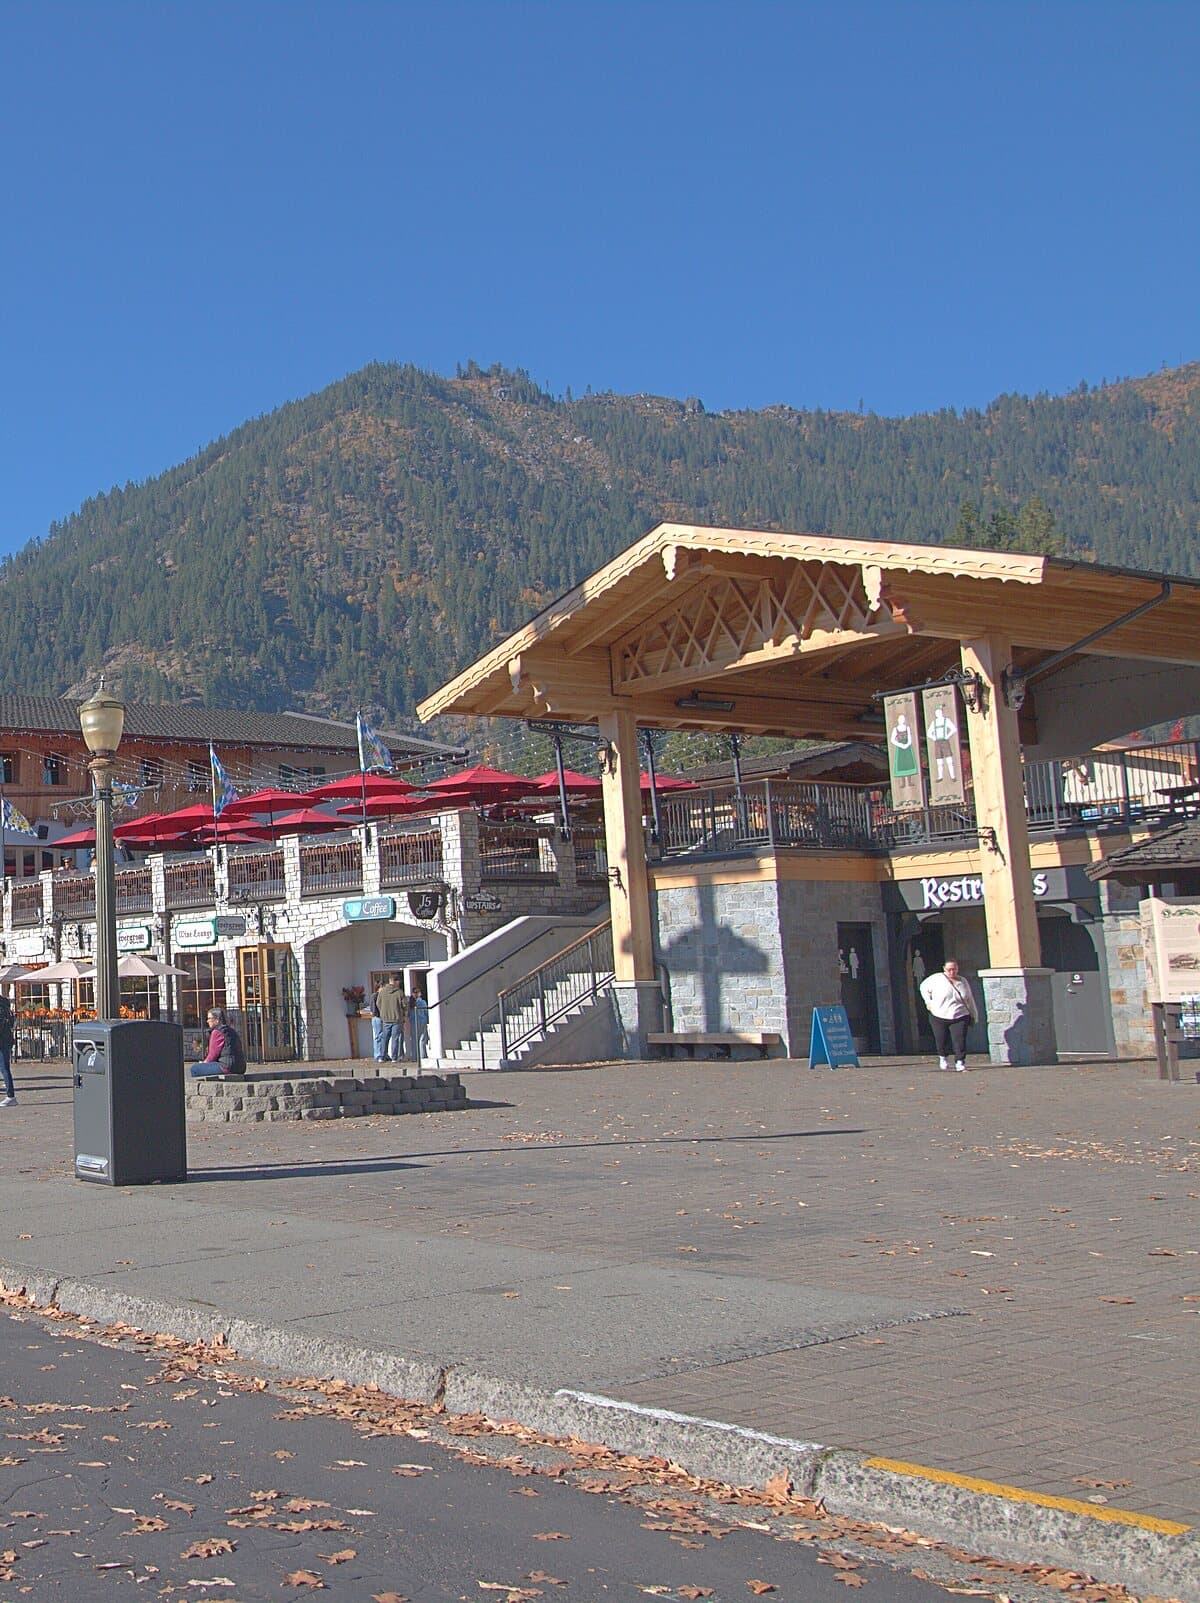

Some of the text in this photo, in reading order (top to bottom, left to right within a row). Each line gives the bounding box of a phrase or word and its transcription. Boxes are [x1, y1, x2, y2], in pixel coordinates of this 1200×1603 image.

[920, 874, 1047, 909] Restrs
[420, 895, 431, 908] J5
[466, 901, 497, 910] UPSTAIRS
[362, 901, 388, 916] Coffee
[416, 906, 434, 917] Coffee
